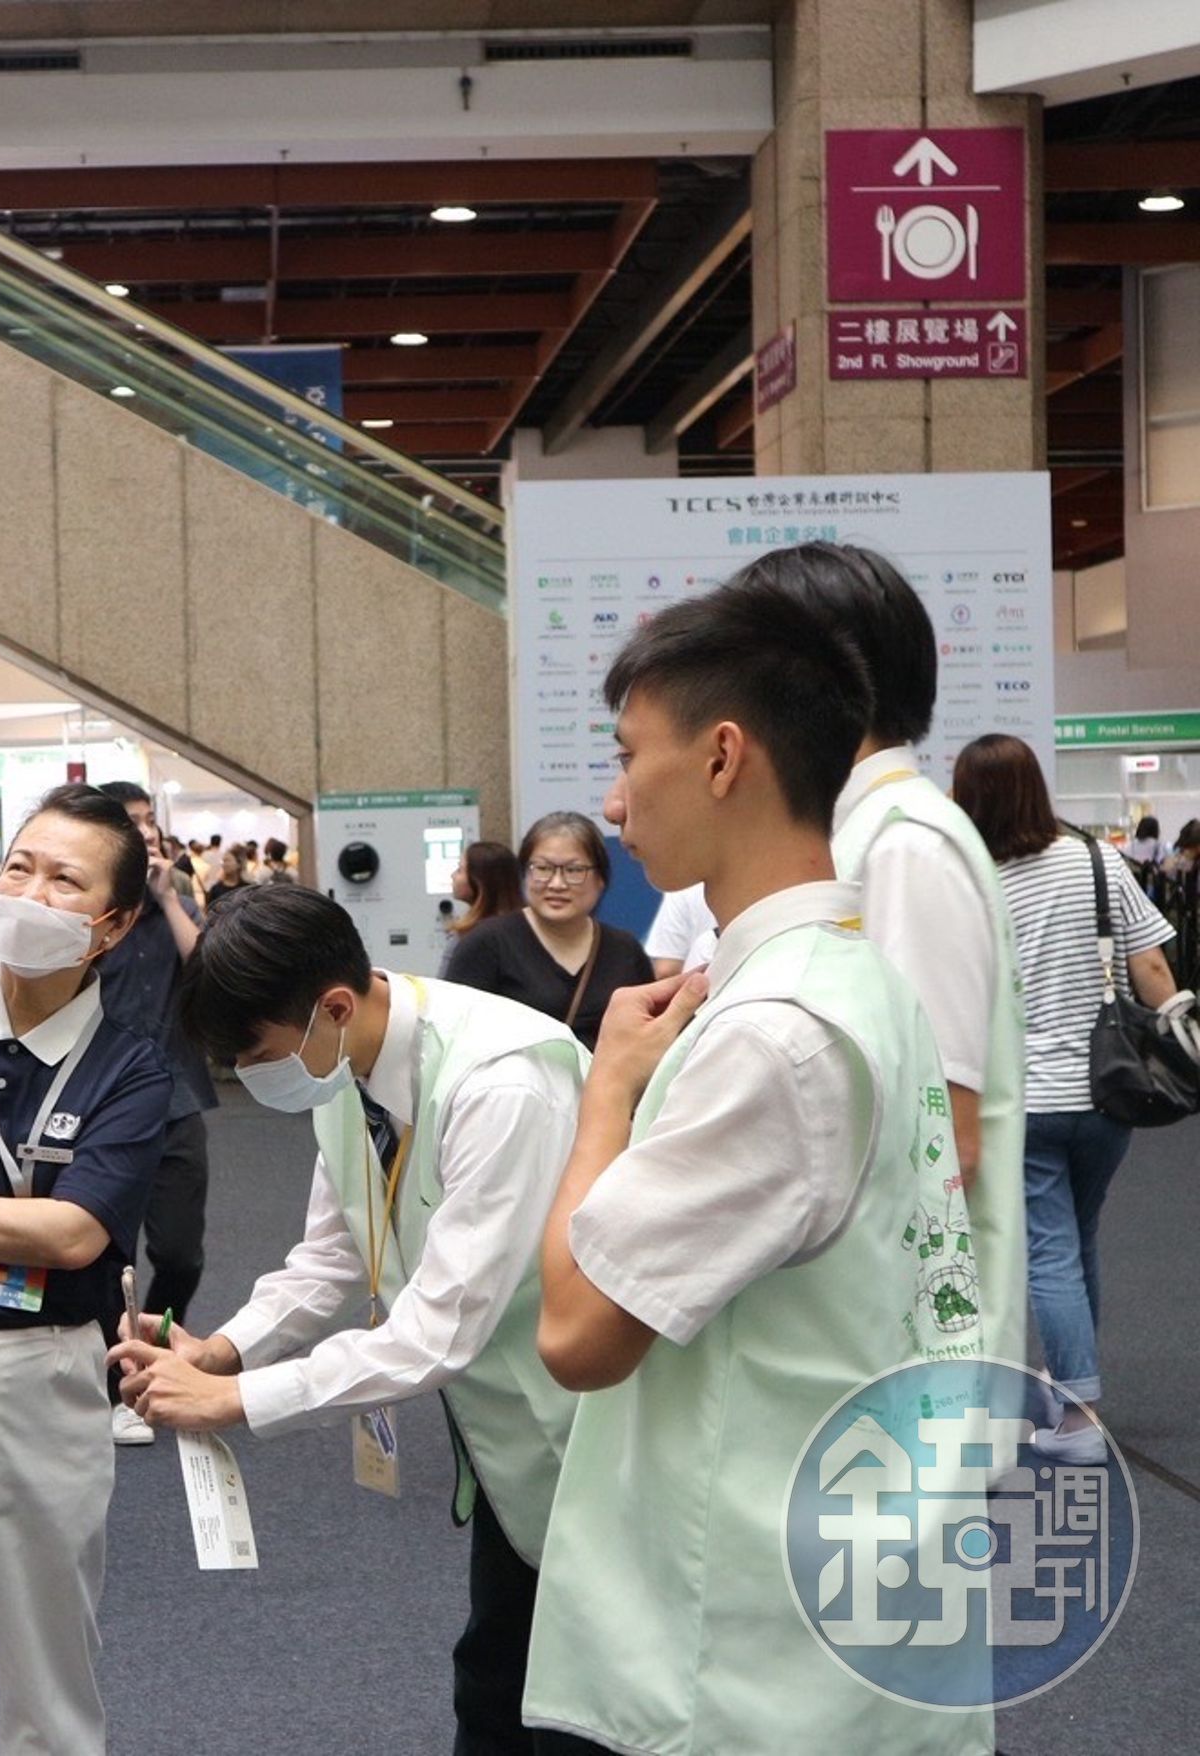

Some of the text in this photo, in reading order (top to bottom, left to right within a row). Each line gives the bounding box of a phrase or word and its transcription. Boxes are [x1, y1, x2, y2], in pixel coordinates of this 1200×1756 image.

[837, 317, 980, 345] 二樓展覽場
[837, 353, 863, 370] 2nd
[897, 352, 980, 371] Showground
[995, 680, 1031, 692] TECO
